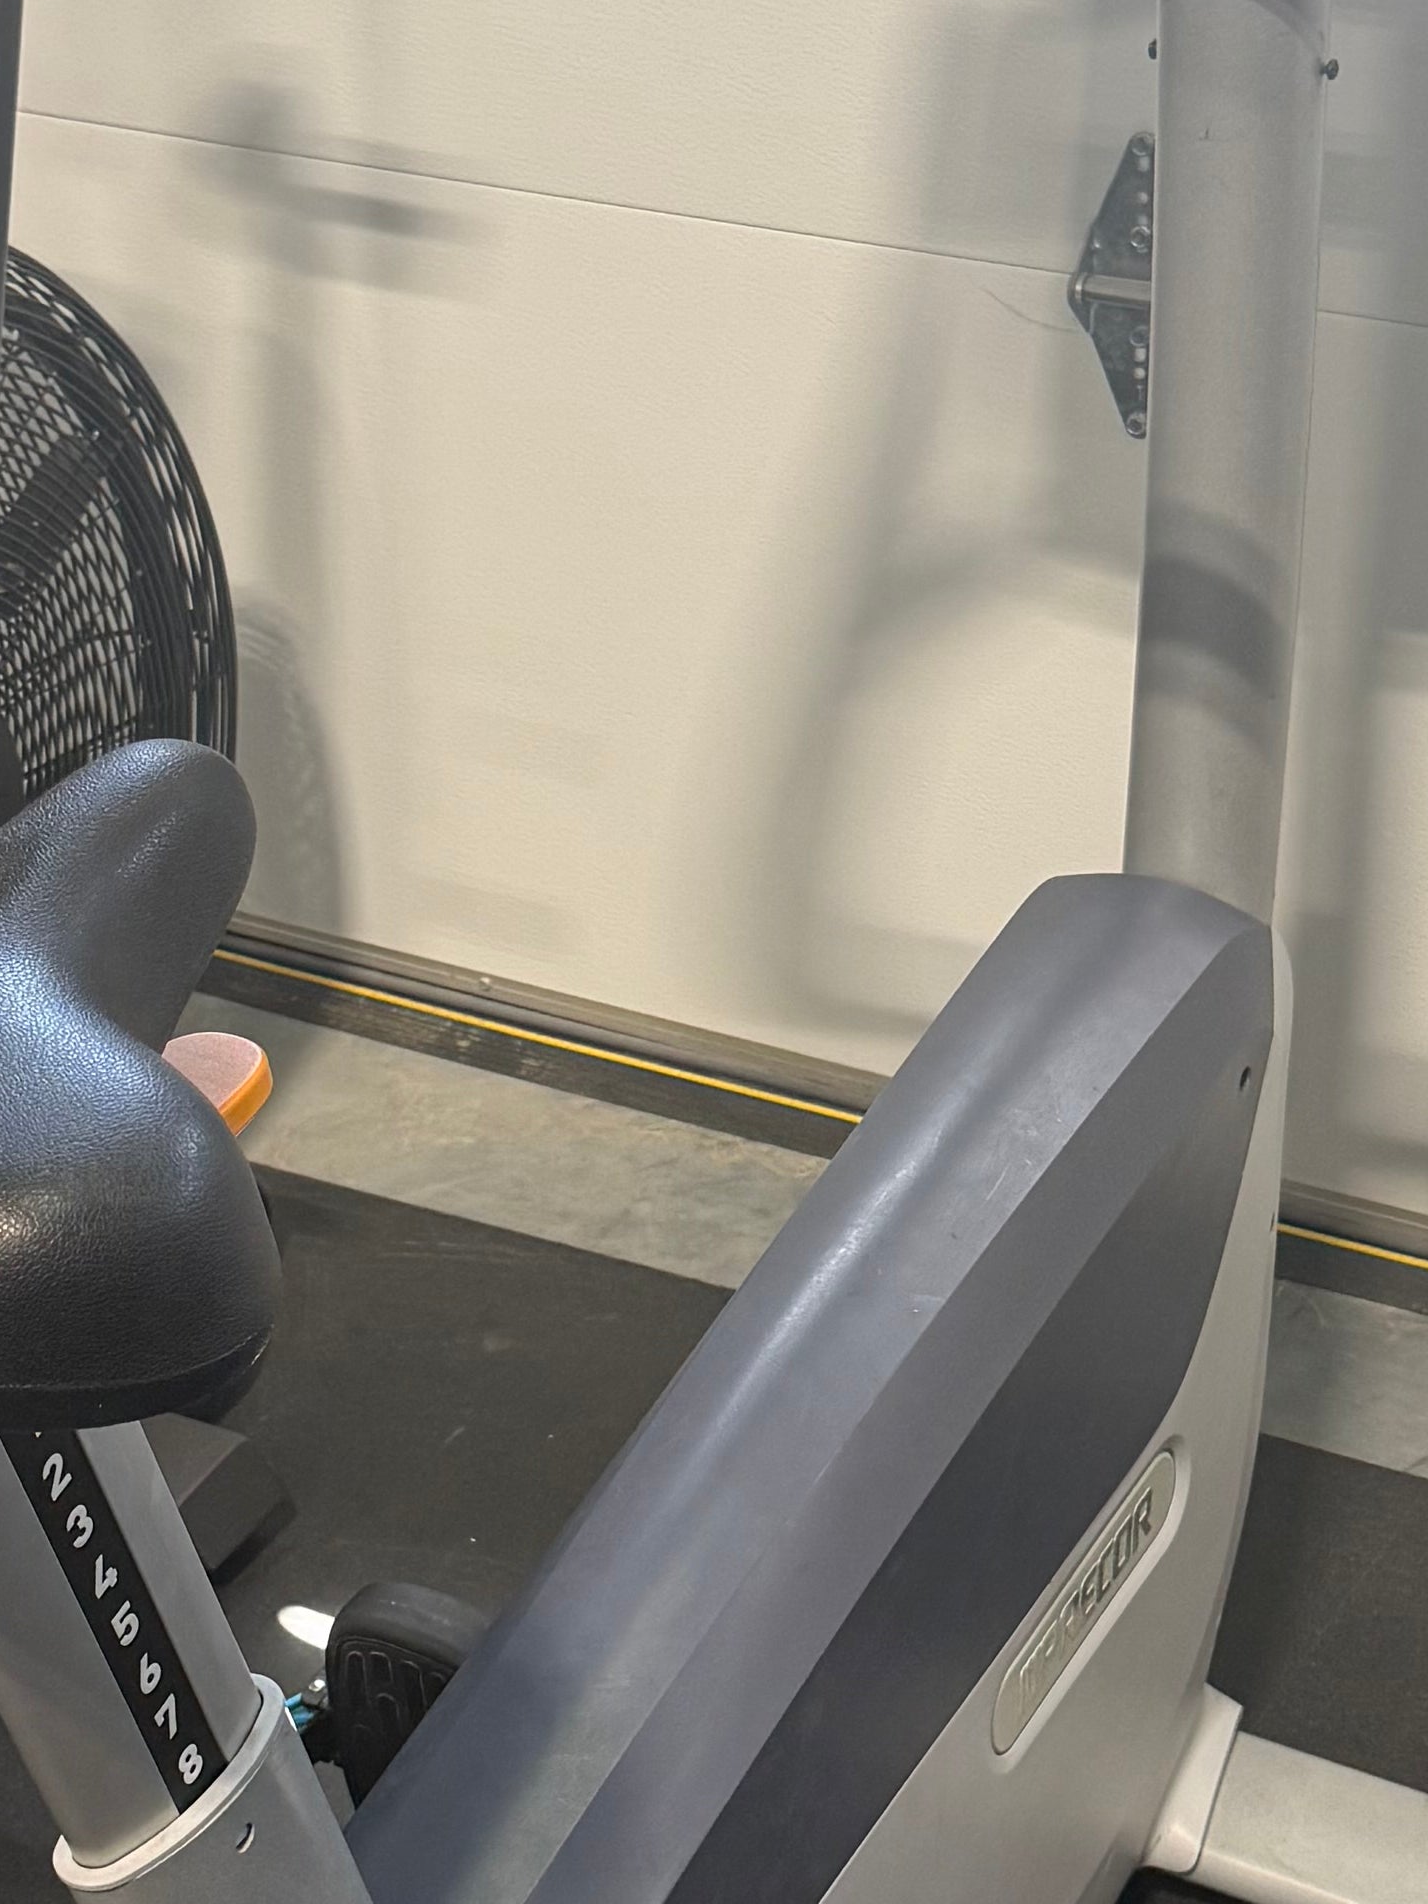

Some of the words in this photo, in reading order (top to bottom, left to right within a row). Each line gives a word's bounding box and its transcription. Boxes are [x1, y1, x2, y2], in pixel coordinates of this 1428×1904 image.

[42, 1453, 72, 1502] 2
[66, 1504, 94, 1548] 3
[95, 1554, 118, 1599] 4
[111, 1601, 139, 1646] 5
[140, 1652, 161, 1695] 6
[154, 1693, 177, 1739] 7
[178, 1744, 203, 1785] 8
